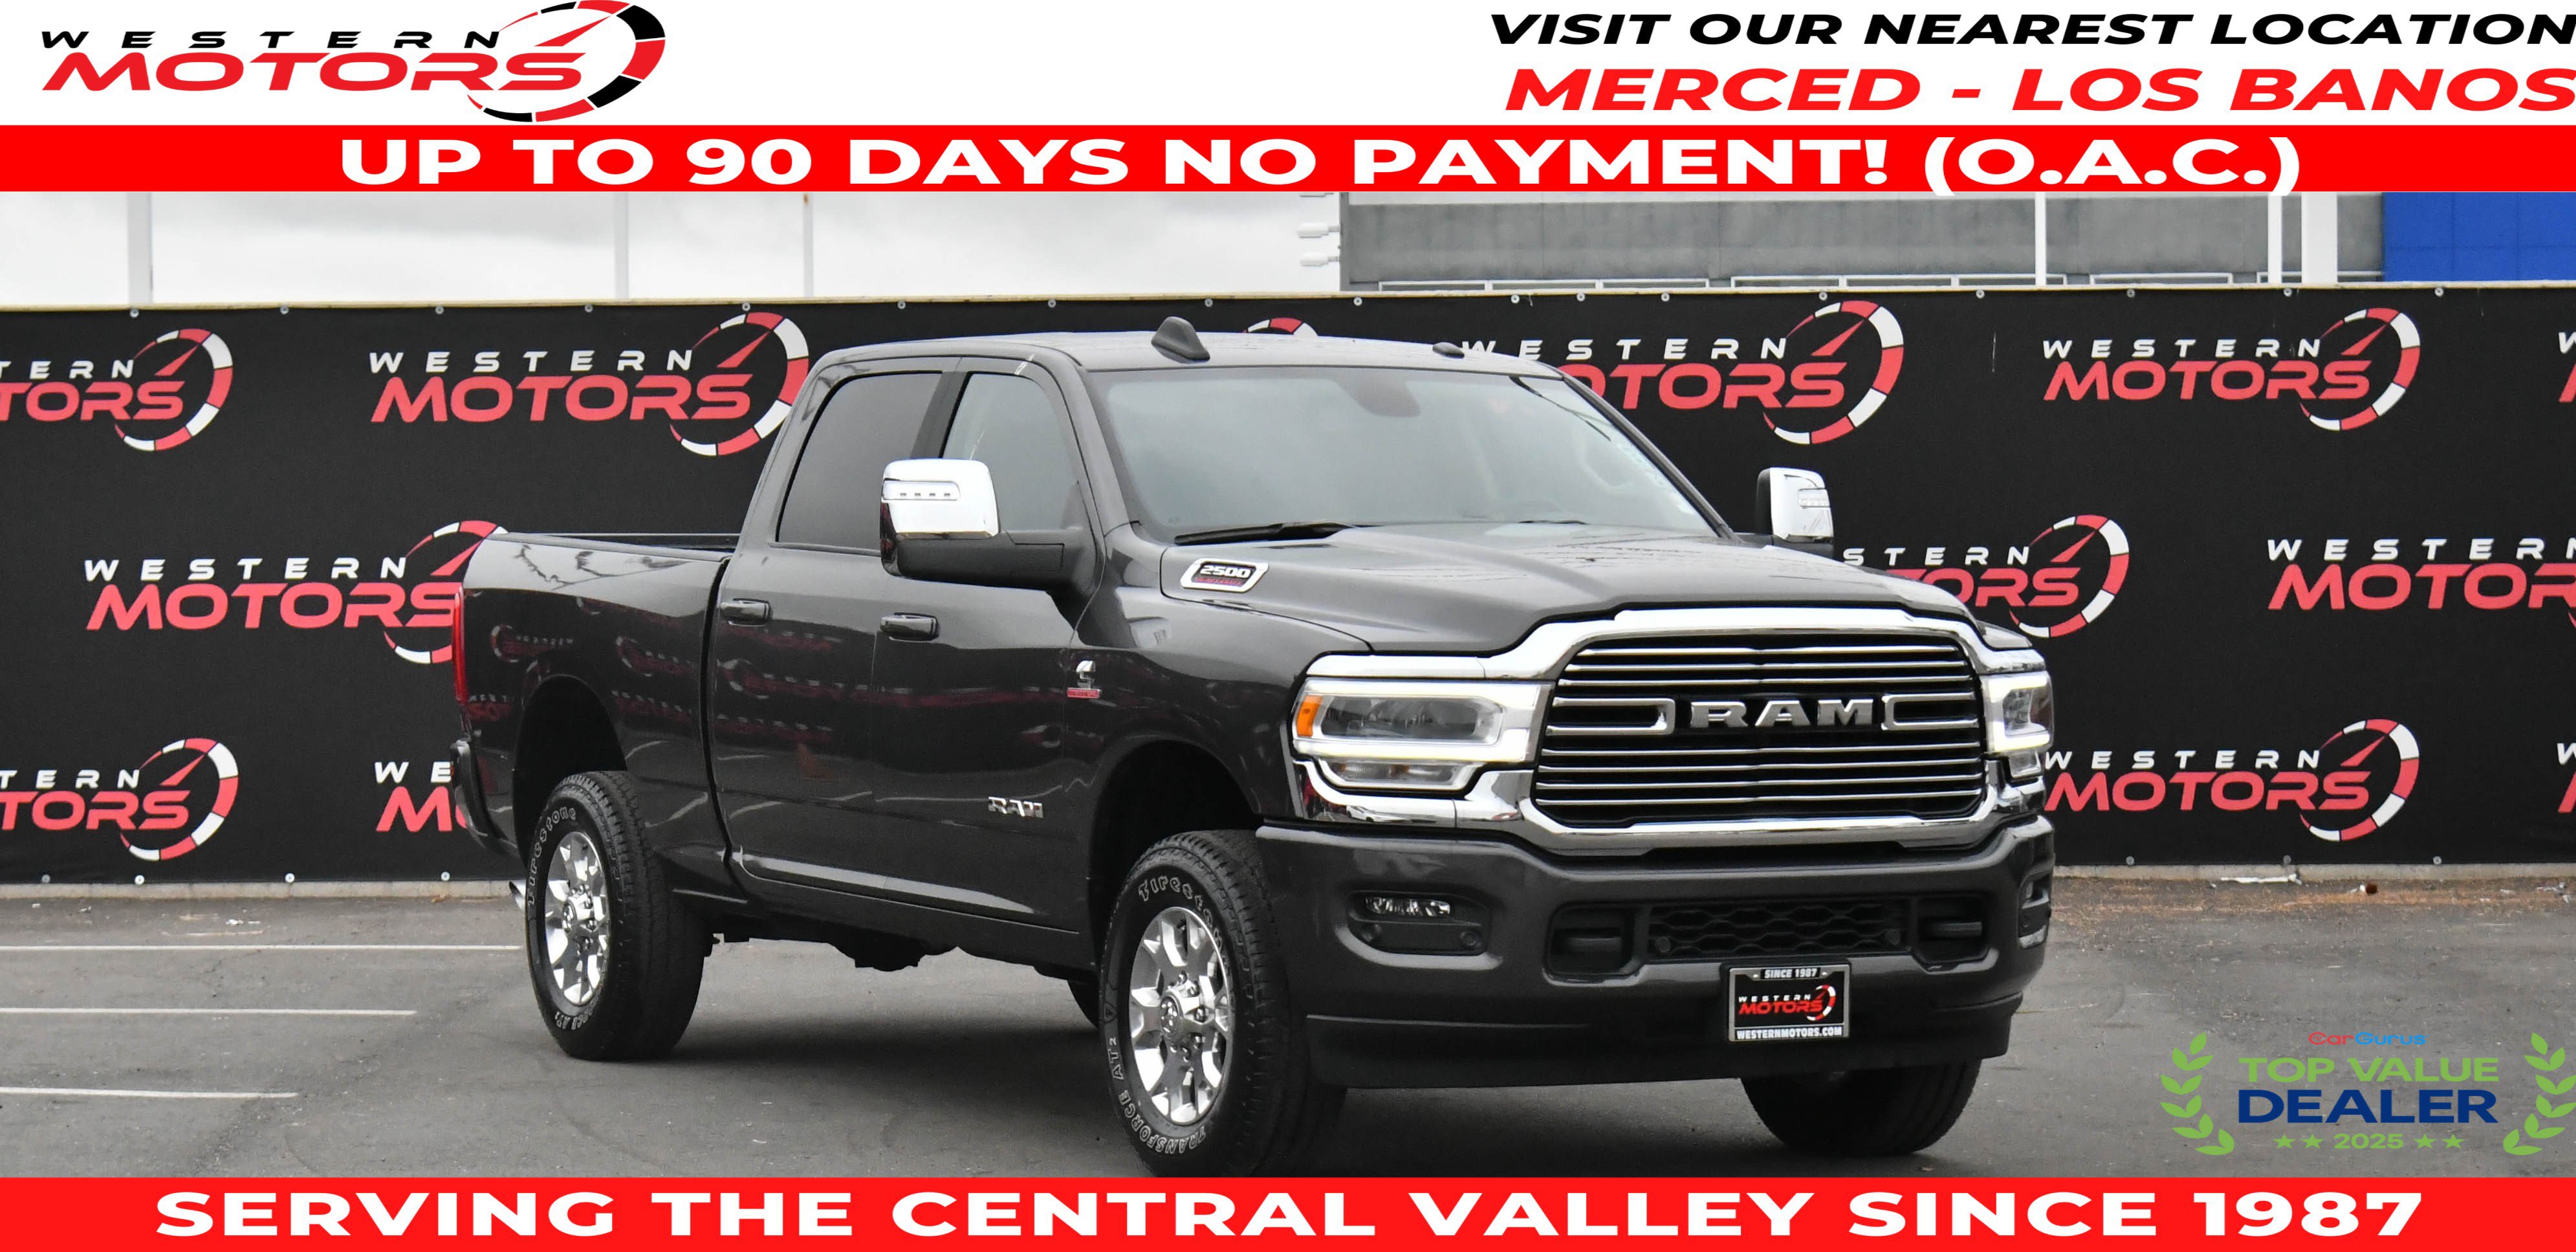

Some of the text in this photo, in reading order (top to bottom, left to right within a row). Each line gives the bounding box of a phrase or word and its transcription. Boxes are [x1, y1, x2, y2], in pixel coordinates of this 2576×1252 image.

[1462, 338, 1787, 362] WESTERN
[2043, 338, 2320, 359] WESTERN
[369, 349, 692, 373] WESTERN
[2043, 360, 2372, 401] MOTORS
[371, 373, 753, 423] MOTORS
[1842, 546, 2029, 567] STERN
[84, 556, 406, 582] WESTERN
[1200, 565, 1251, 578] 2500
[86, 582, 462, 631] MOTORS
[1690, 699, 1874, 729] RAM
[2045, 750, 2320, 770] WESTERN
[2045, 771, 2370, 812] MOTORS
[988, 796, 1043, 818] RAM
[1764, 968, 1818, 979] SINCE 1987
[1738, 994, 1811, 1002] WESTERN
[1738, 1000, 1823, 1015] MOTORS
[1736, 1026, 1842, 1040] WESTERNMOTORS.COM
